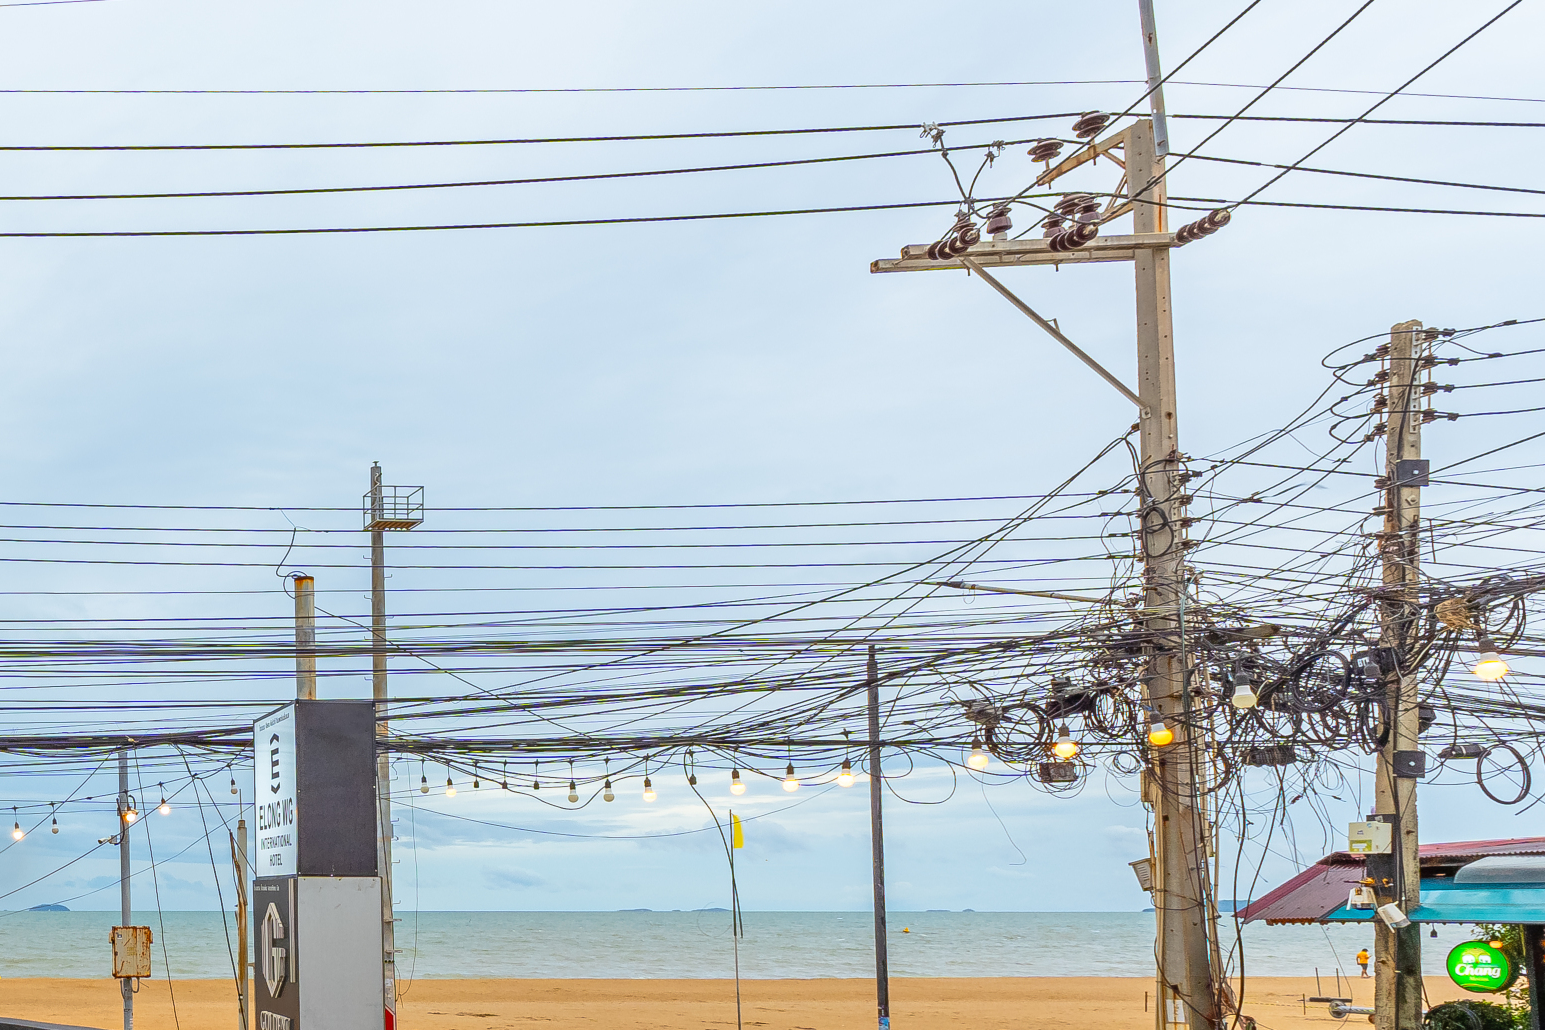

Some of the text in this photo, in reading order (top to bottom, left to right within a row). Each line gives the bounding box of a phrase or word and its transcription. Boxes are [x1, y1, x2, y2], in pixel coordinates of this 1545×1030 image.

[259, 797, 293, 831] ELONG WG
[260, 833, 292, 850] INTERNATIONAL
[269, 853, 283, 867] HOTEL
[1454, 963, 1501, 979] Chang
